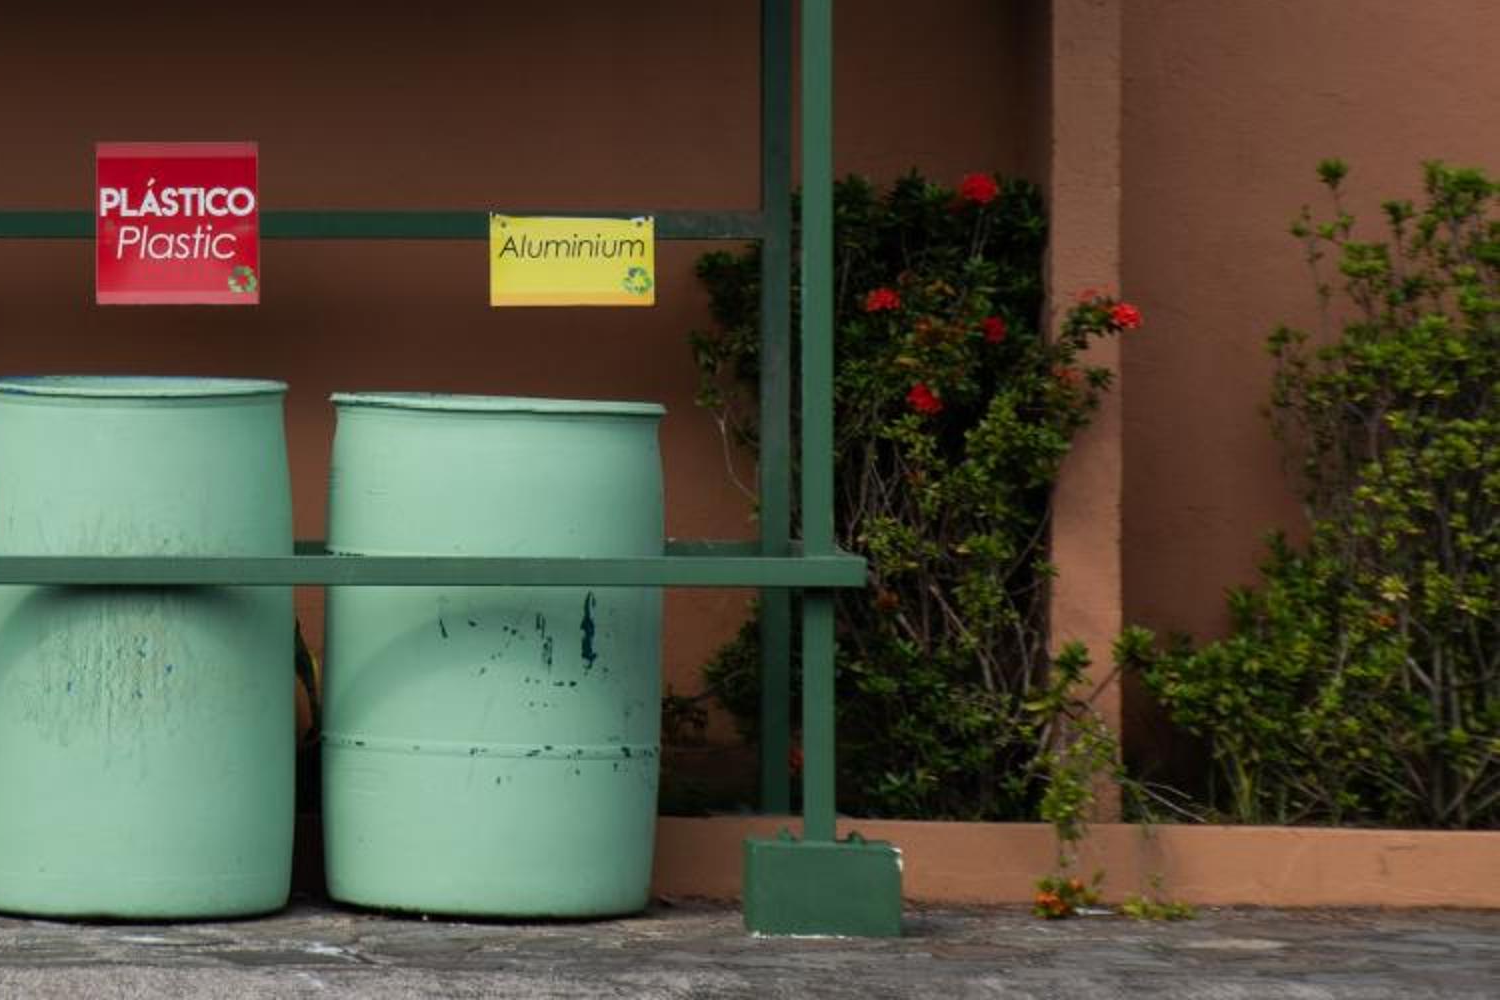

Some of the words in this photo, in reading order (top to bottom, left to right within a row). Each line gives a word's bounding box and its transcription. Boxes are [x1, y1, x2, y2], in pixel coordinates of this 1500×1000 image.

[100, 178, 255, 217] PLÁSTICO
[116, 225, 237, 260] Plastic
[500, 234, 646, 259] Aluminium
